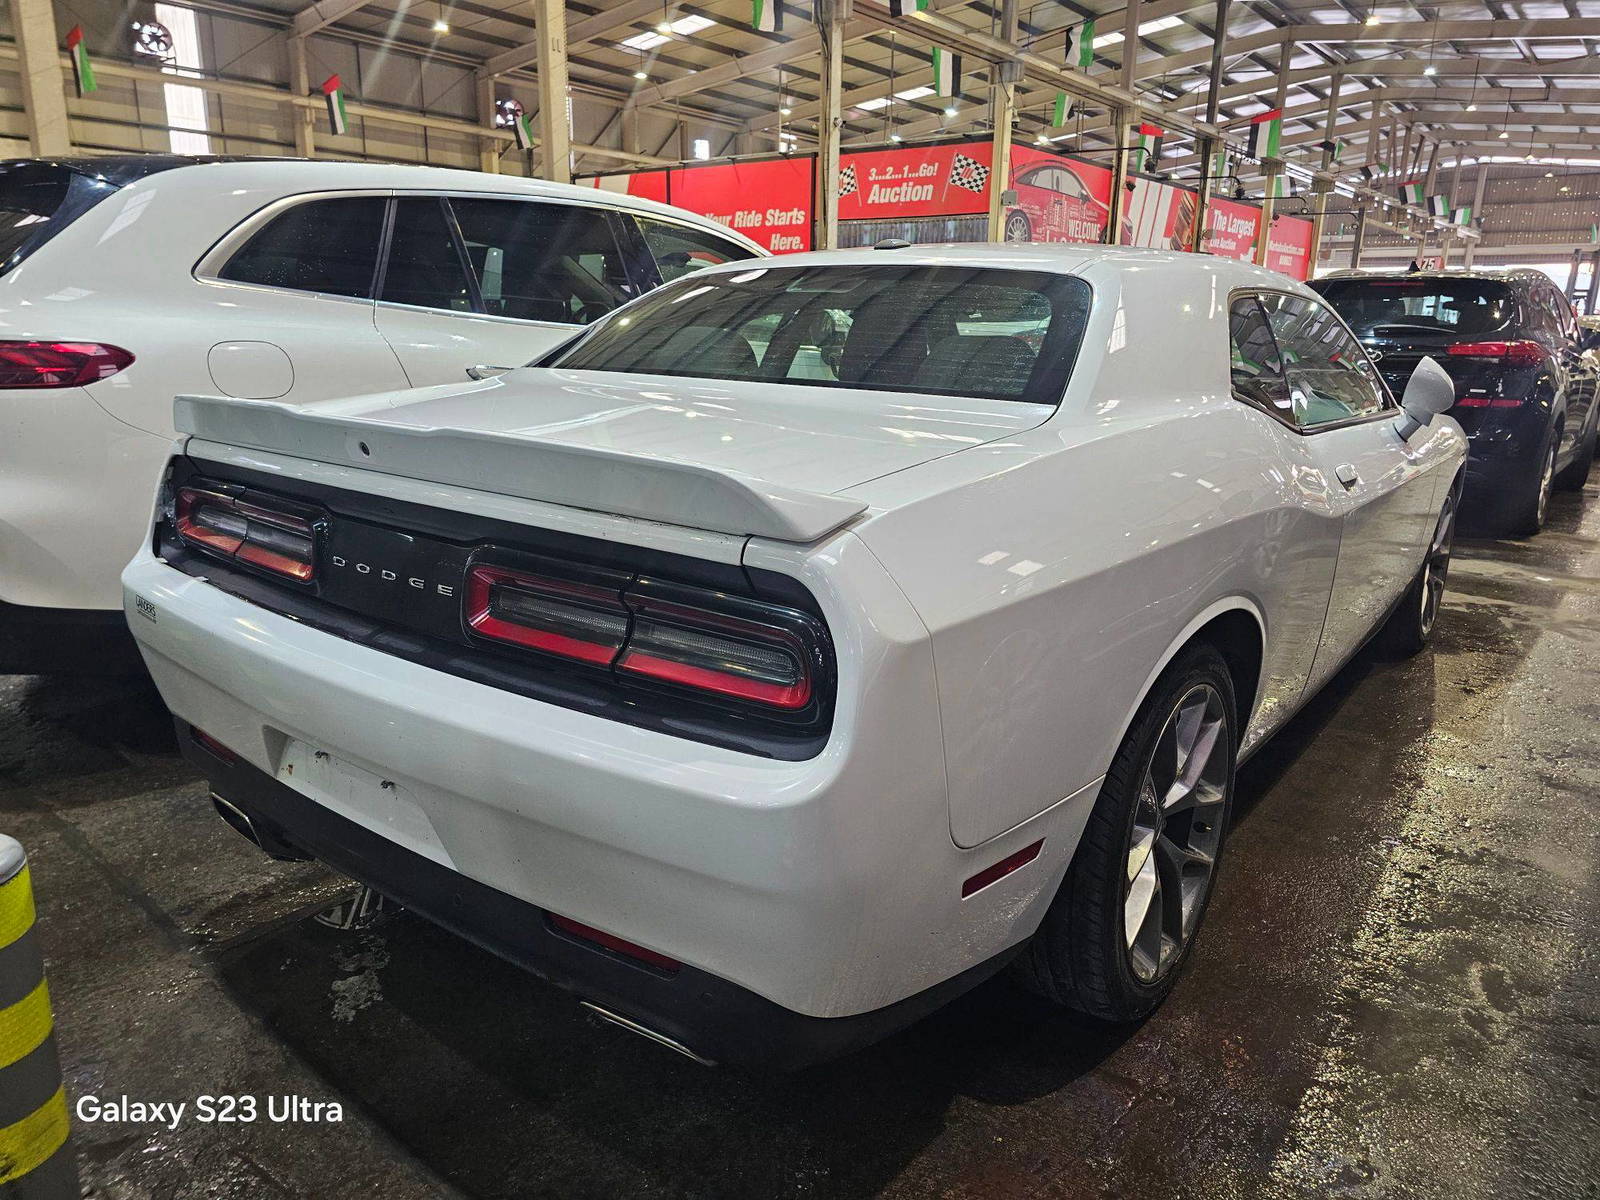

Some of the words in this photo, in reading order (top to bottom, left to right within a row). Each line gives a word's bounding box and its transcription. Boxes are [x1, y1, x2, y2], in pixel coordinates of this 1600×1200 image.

[867, 181, 934, 204] Auction
[734, 210, 763, 228] Ride
[765, 208, 806, 227] Starts
[1213, 209, 1227, 231] The
[1227, 212, 1256, 239] Largest
[1068, 219, 1101, 241] WELCOME
[770, 233, 804, 251] Here.
[332, 555, 454, 597] DODGE
